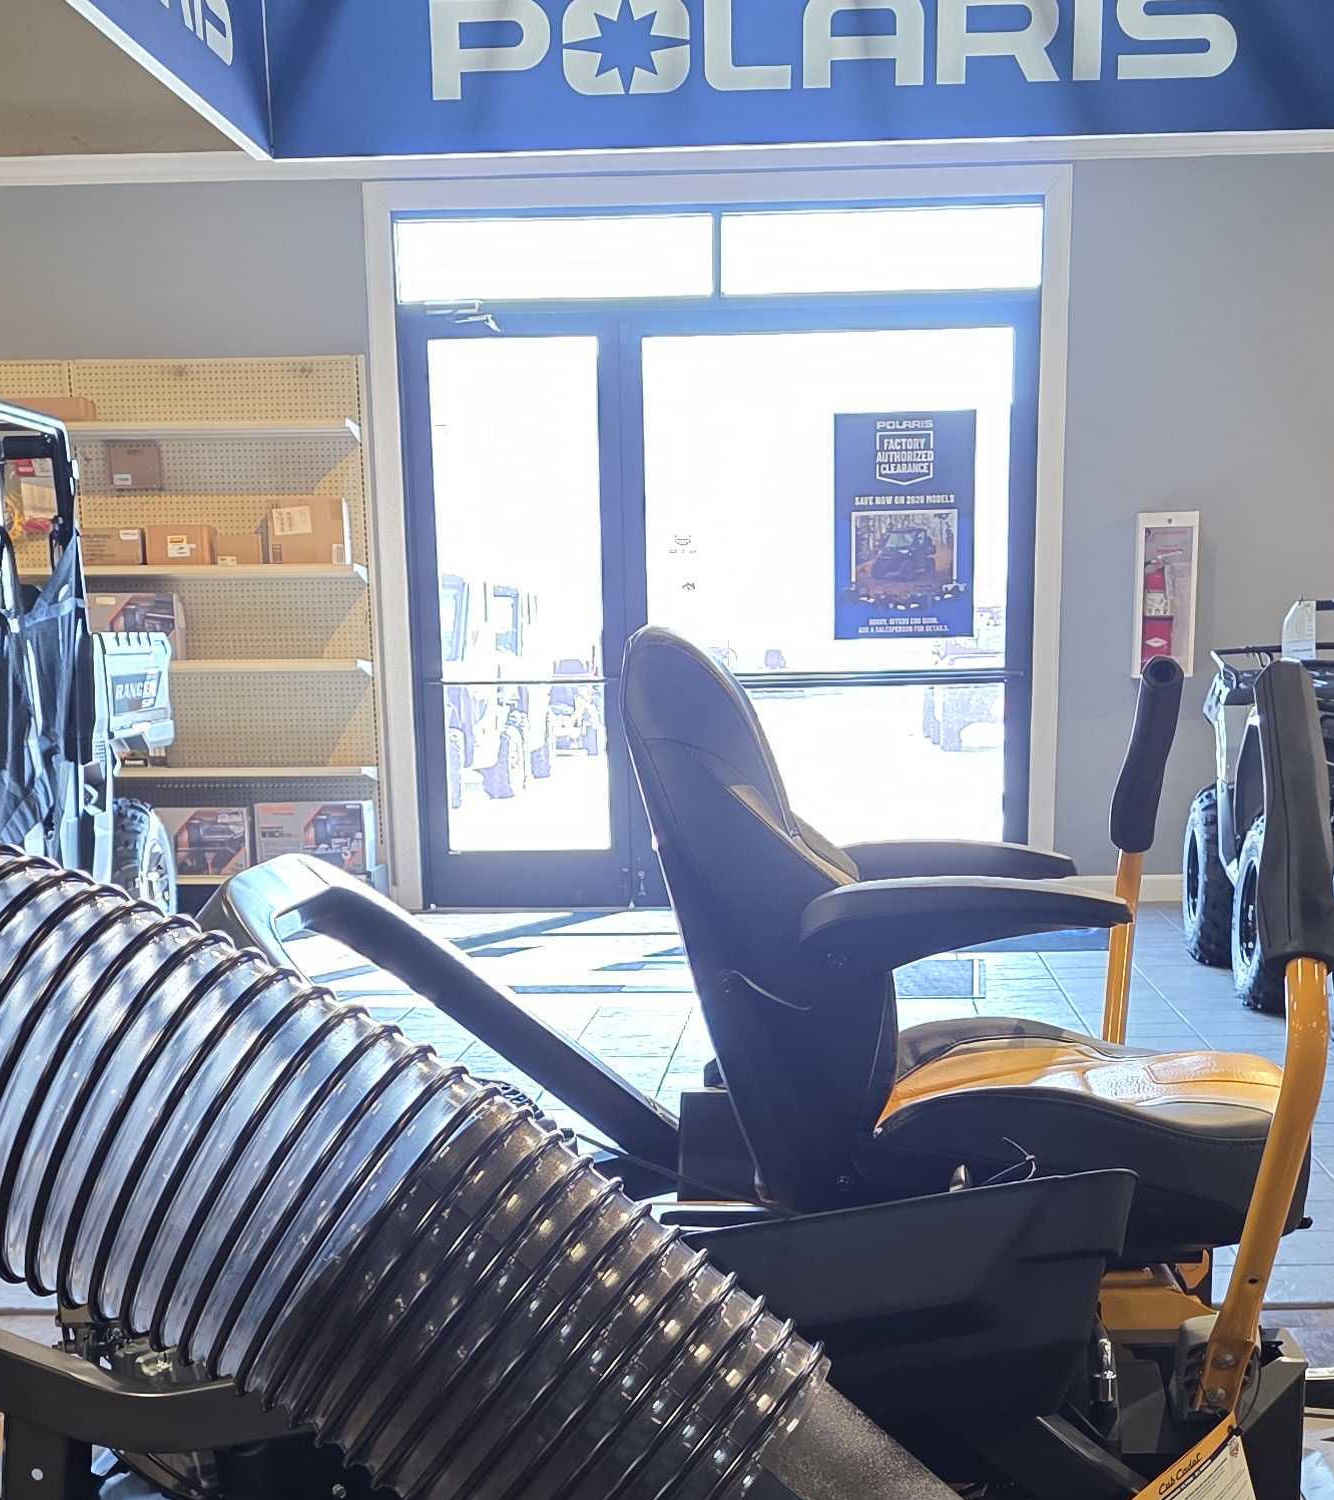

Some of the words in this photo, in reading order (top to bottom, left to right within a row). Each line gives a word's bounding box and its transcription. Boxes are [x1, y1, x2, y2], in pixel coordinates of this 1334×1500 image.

[430, 0, 1239, 101] POLARIS
[876, 420, 933, 429] POLARIS
[884, 438, 926, 450] FACTORY
[876, 450, 934, 462] AUTHORIZED
[880, 463, 929, 474] CLEARANCE
[854, 496, 874, 505] SAVE
[875, 496, 893, 504] NOW
[926, 494, 955, 503] MODELS
[115, 681, 156, 699] RANGER
[1158, 1475, 1176, 1495] Cub
[1176, 1452, 1204, 1481] Cadet
